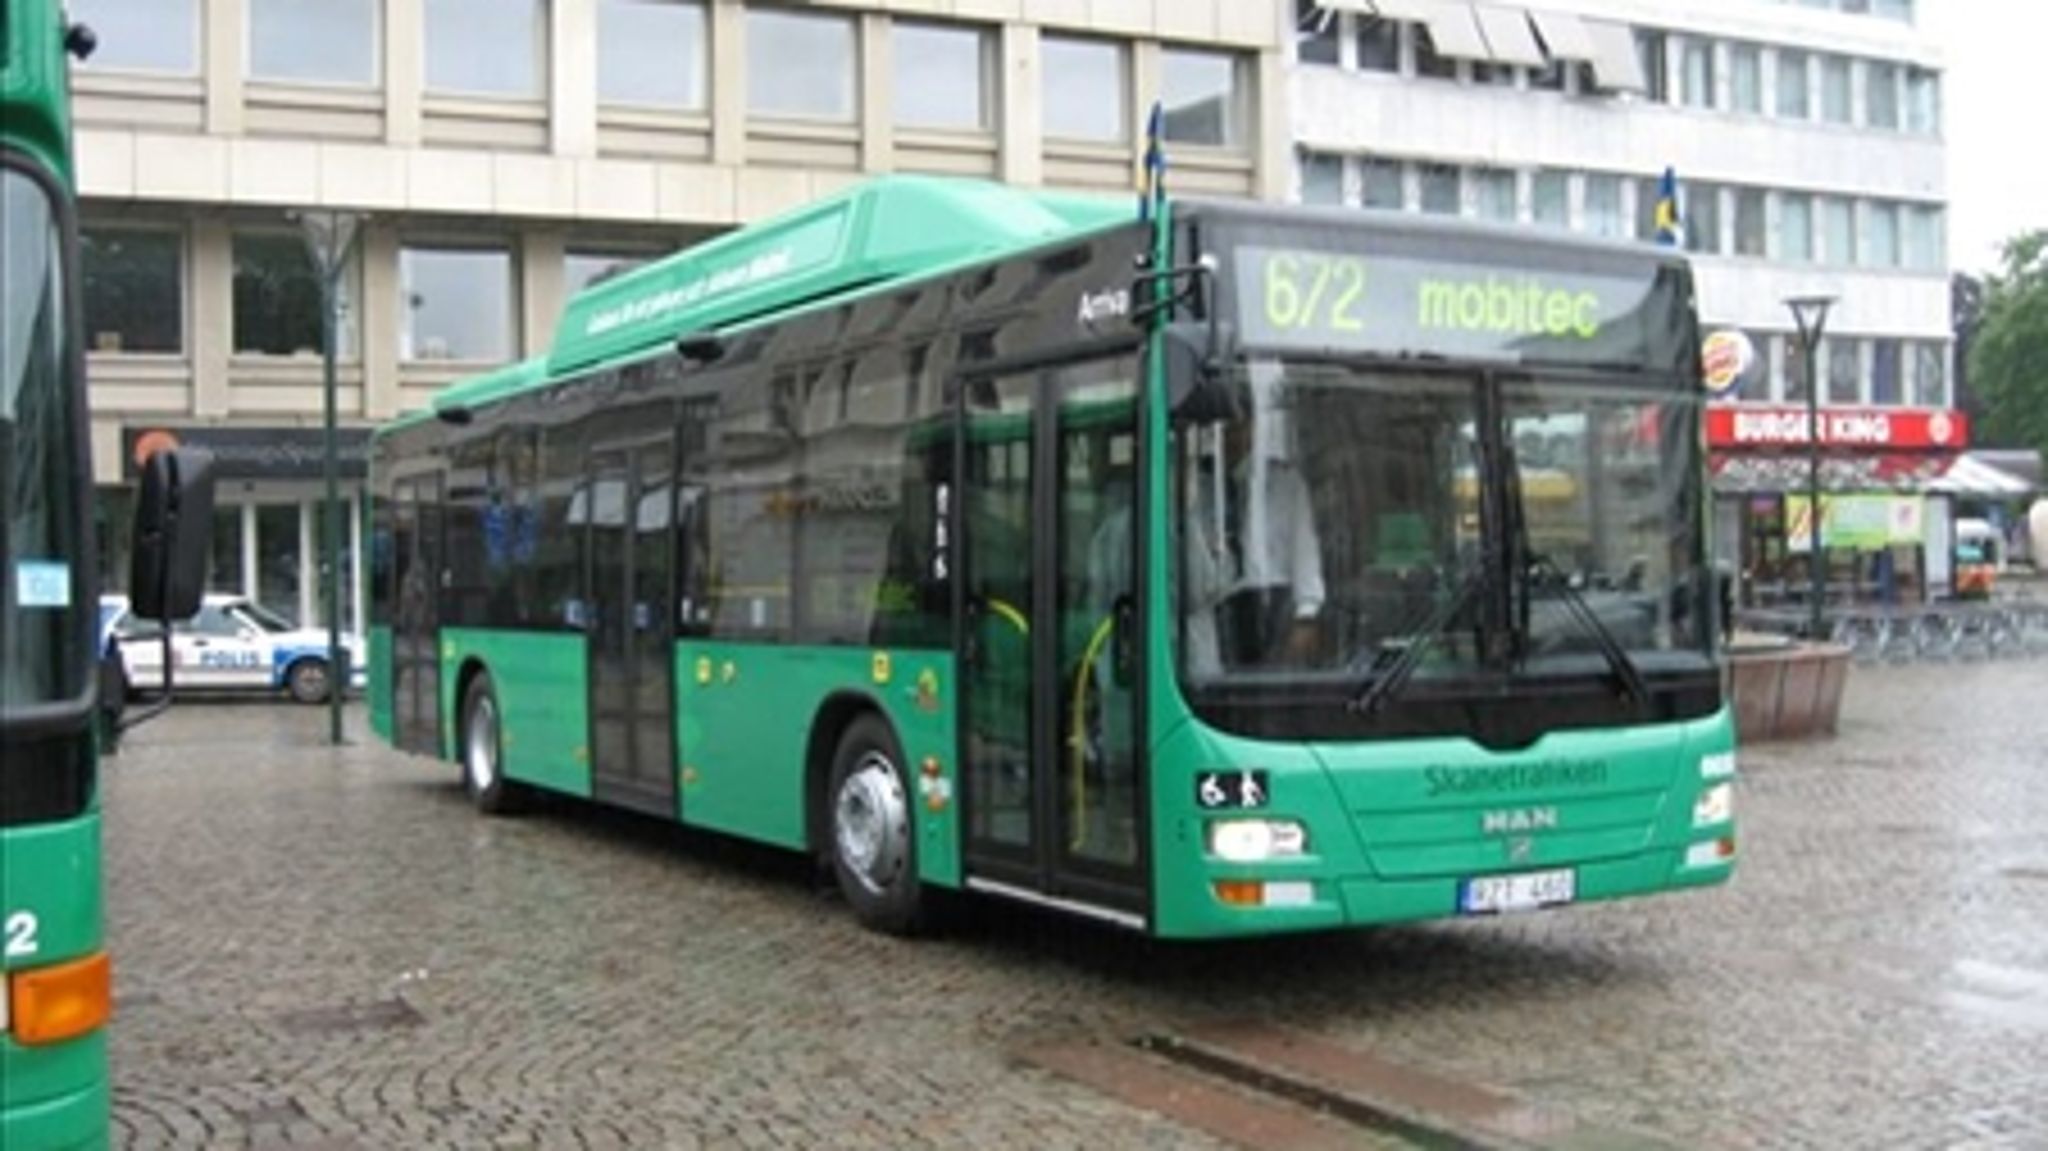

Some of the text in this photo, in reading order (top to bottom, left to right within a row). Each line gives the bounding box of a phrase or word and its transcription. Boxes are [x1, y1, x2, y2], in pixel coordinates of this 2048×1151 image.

[1418, 277, 1600, 338] mobitec
[1733, 411, 1891, 444] BURGER KING
[200, 650, 260, 670] POLIS
[1482, 805, 1560, 834] MAN
[4, 911, 38, 955] 2
